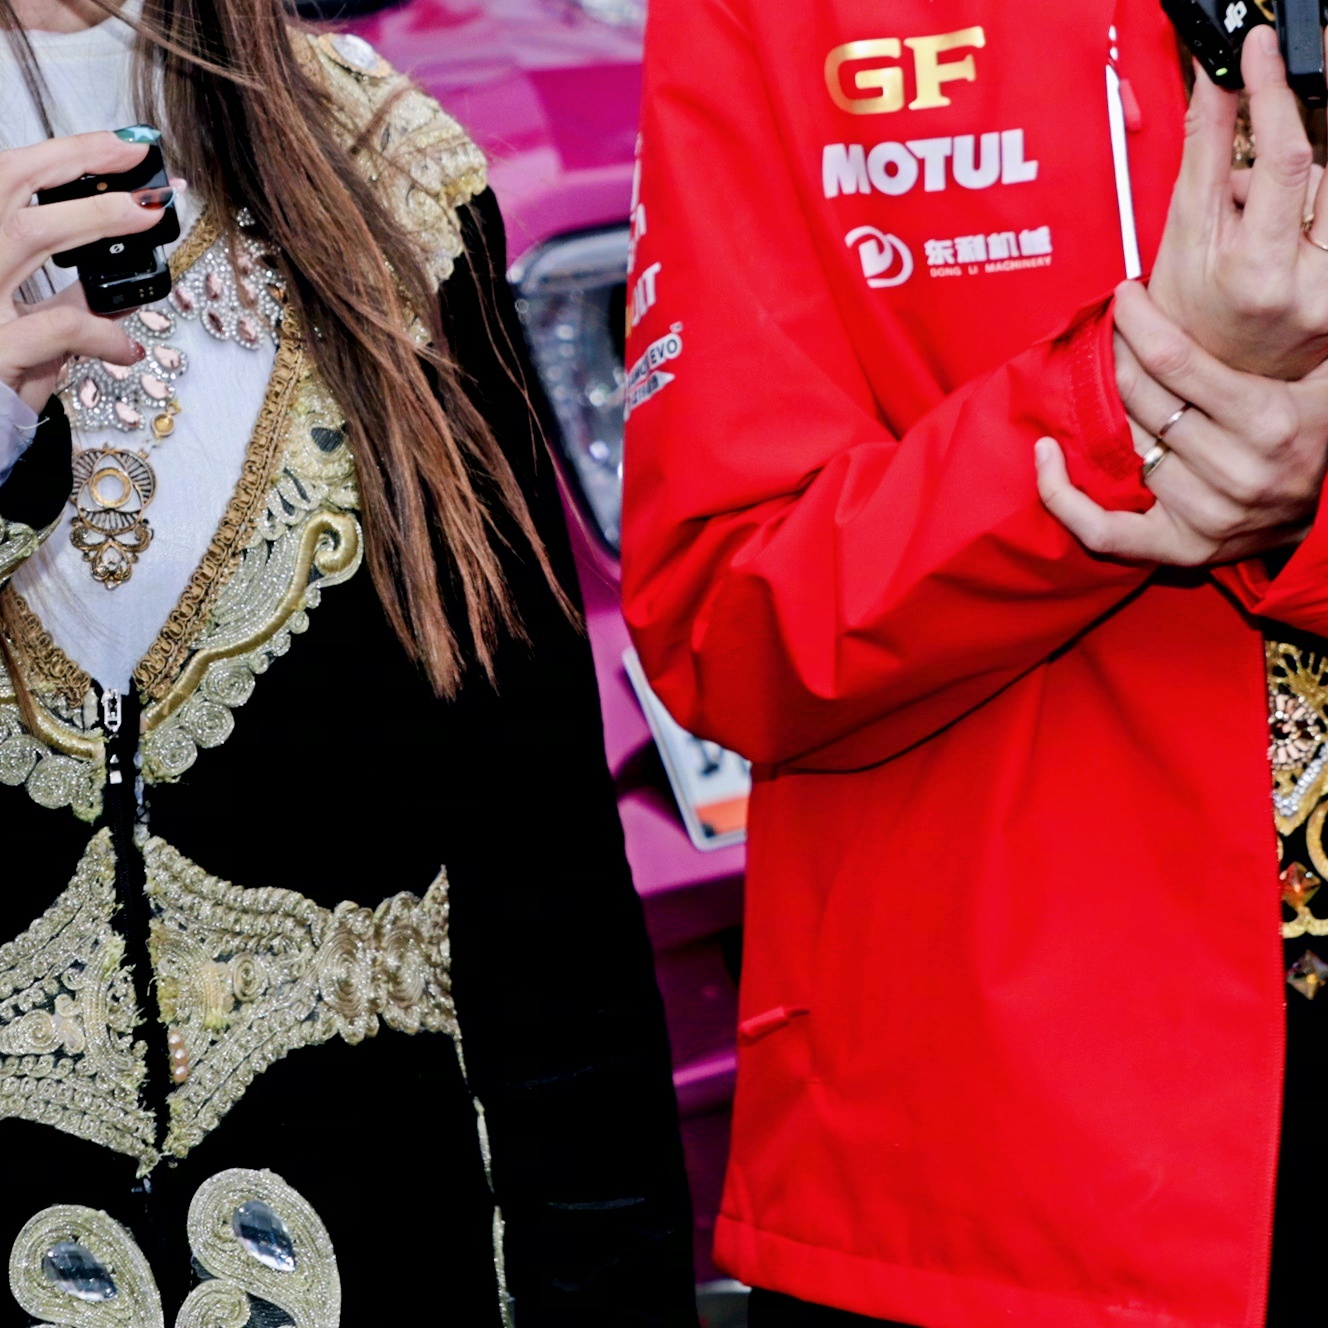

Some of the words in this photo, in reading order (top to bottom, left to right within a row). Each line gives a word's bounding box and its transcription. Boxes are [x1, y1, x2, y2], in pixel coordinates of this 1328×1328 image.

[824, 25, 986, 115] GF
[823, 128, 1039, 200] MOTUL
[924, 225, 1053, 266] 东利机械
[929, 266, 962, 278] DONG
[984, 255, 1052, 274] MACHINERY
